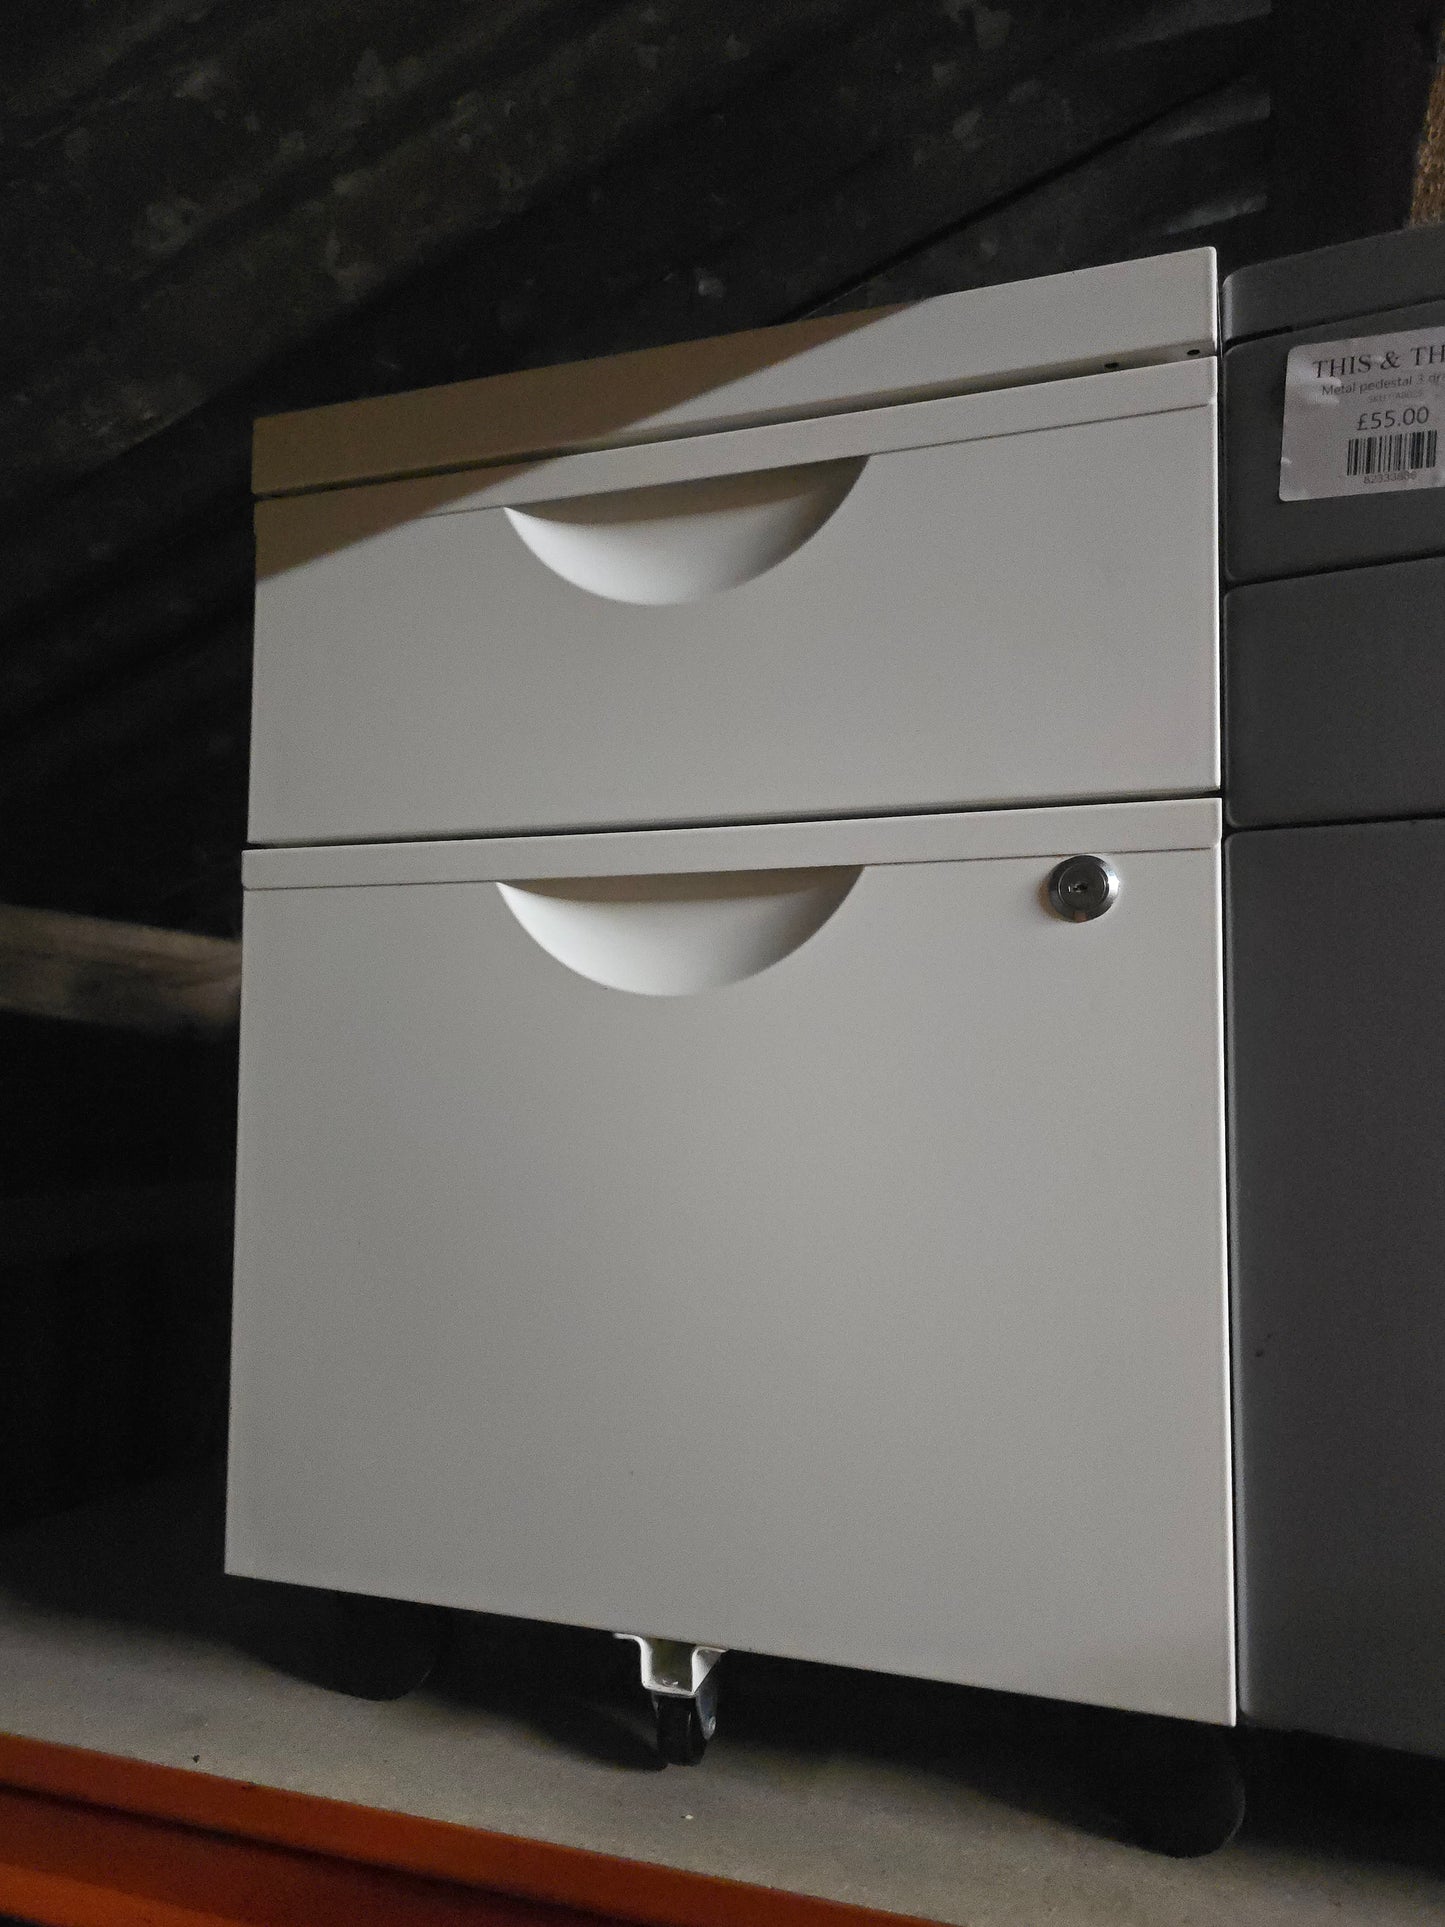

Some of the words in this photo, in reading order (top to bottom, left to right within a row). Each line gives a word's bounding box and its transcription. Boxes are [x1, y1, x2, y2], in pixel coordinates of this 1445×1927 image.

[1312, 354, 1372, 378] THIS
[1380, 351, 1401, 370] &
[1322, 383, 1356, 396] Metal
[1359, 376, 1412, 394] pedestal
[1356, 406, 1430, 431] £55.00
